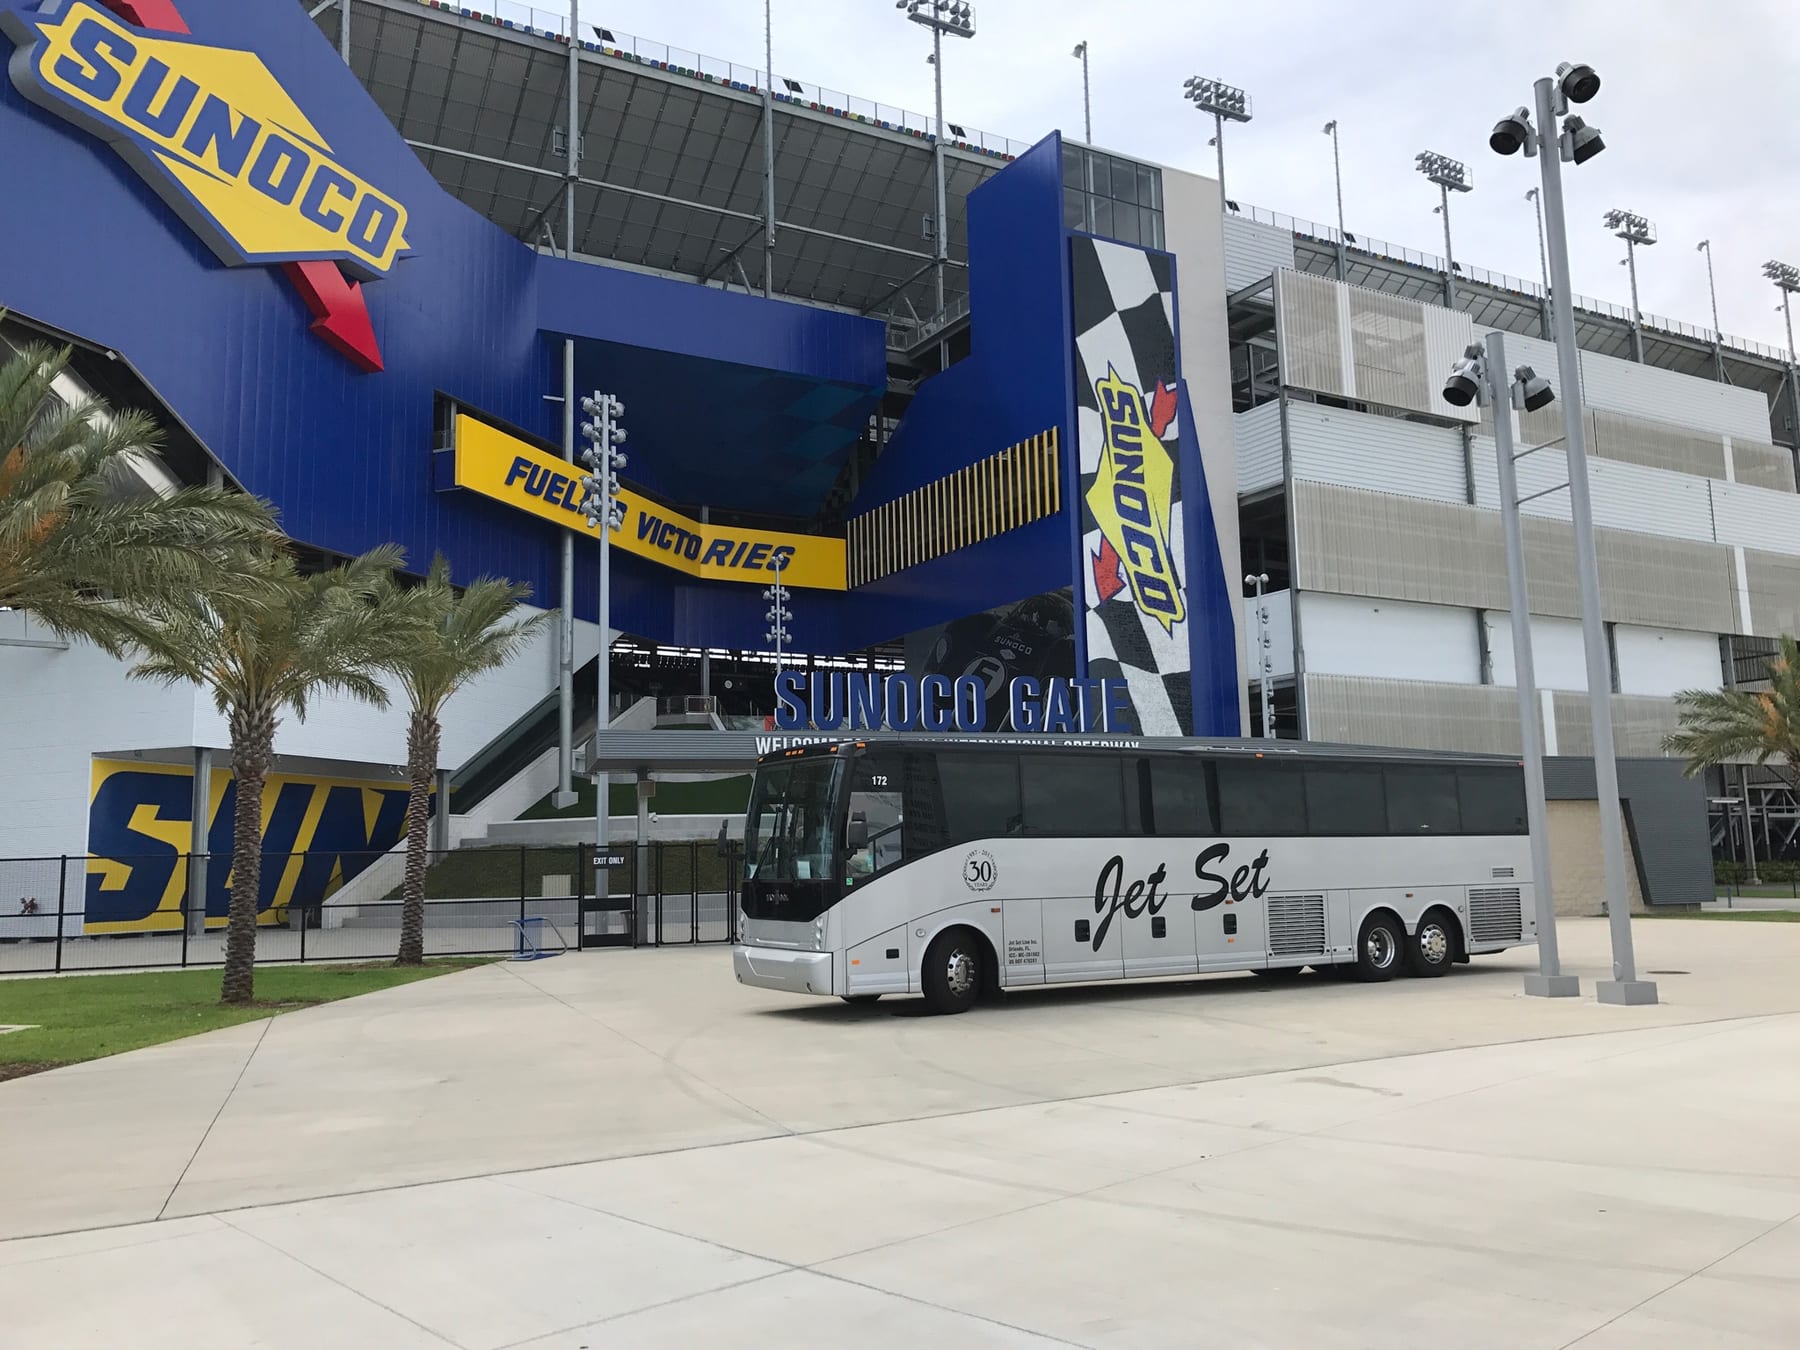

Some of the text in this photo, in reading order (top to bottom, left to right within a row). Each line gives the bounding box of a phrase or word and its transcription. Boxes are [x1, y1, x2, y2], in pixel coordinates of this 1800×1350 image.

[54, 18, 399, 258] SUNOCO
[1102, 387, 1178, 615] SUNOCO
[637, 511, 796, 572] VICTORIES
[994, 635, 1033, 655] SUNOCO
[774, 671, 986, 732] SUNOCO
[1010, 676, 1132, 733] GATE
[871, 775, 888, 785] 172
[593, 856, 625, 865] EXIT ONLY
[968, 860, 992, 882] 30
[1092, 842, 1271, 952] Jet Set
